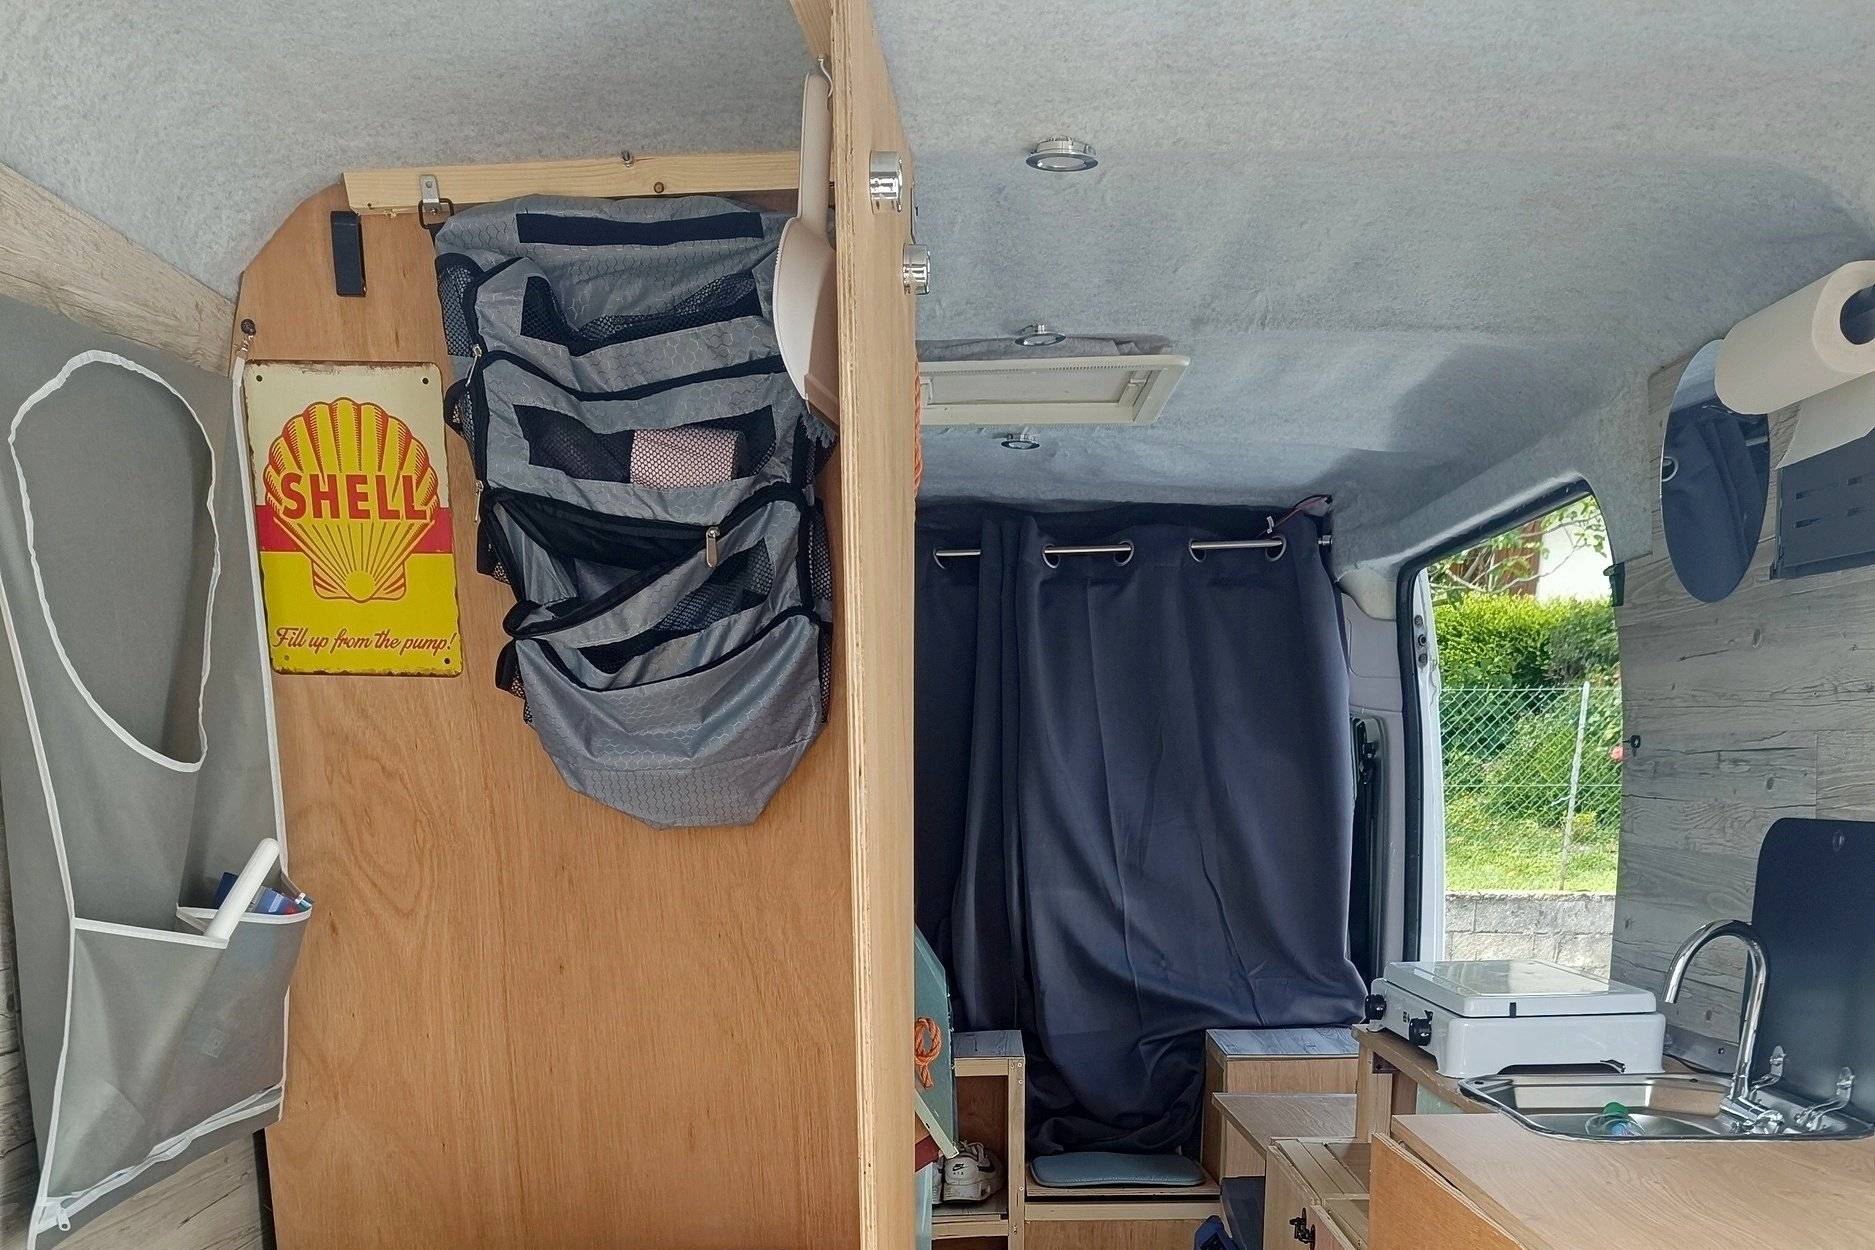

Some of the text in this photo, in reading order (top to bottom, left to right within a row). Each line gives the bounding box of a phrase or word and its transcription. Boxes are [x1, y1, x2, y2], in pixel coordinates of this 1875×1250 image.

[281, 473, 427, 521] SHELL
[274, 627, 457, 656] Fill up from the pump!
